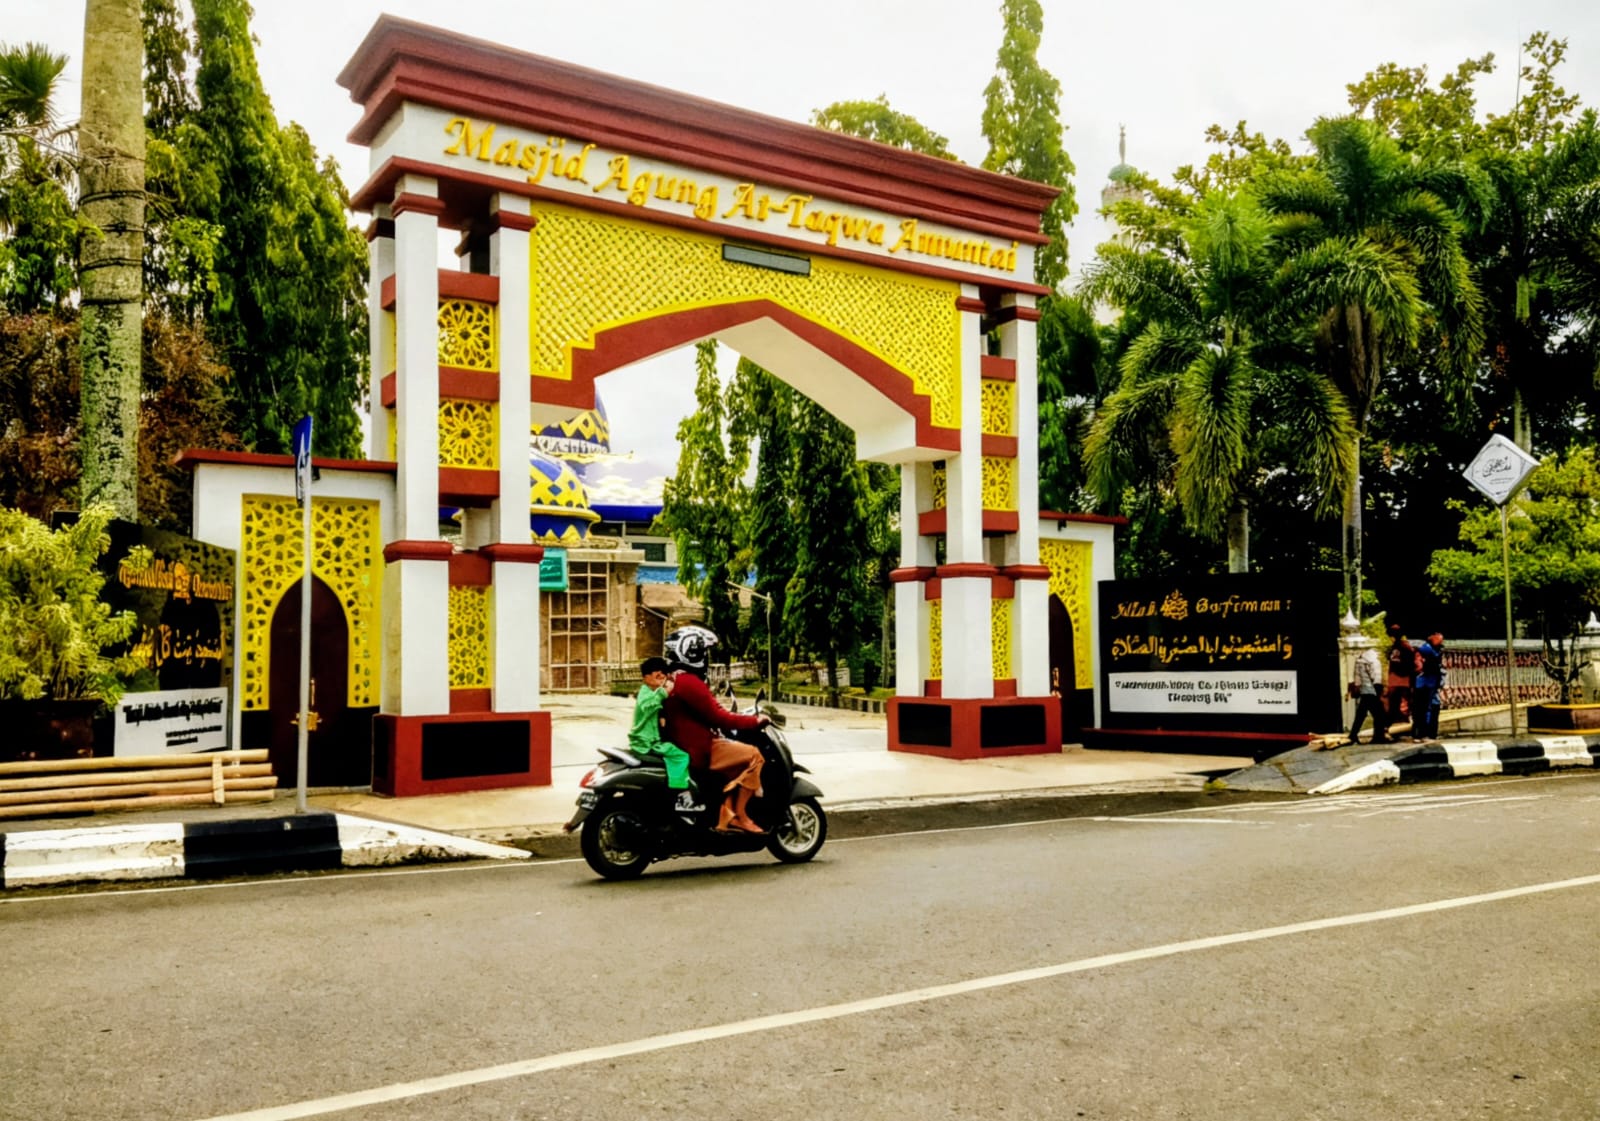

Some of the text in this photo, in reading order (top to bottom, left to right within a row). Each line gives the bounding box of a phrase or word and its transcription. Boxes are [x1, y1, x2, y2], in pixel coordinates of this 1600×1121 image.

[444, 116, 597, 185] Masjid
[593, 154, 719, 220] Agung
[888, 218, 1019, 272] Amuntai
